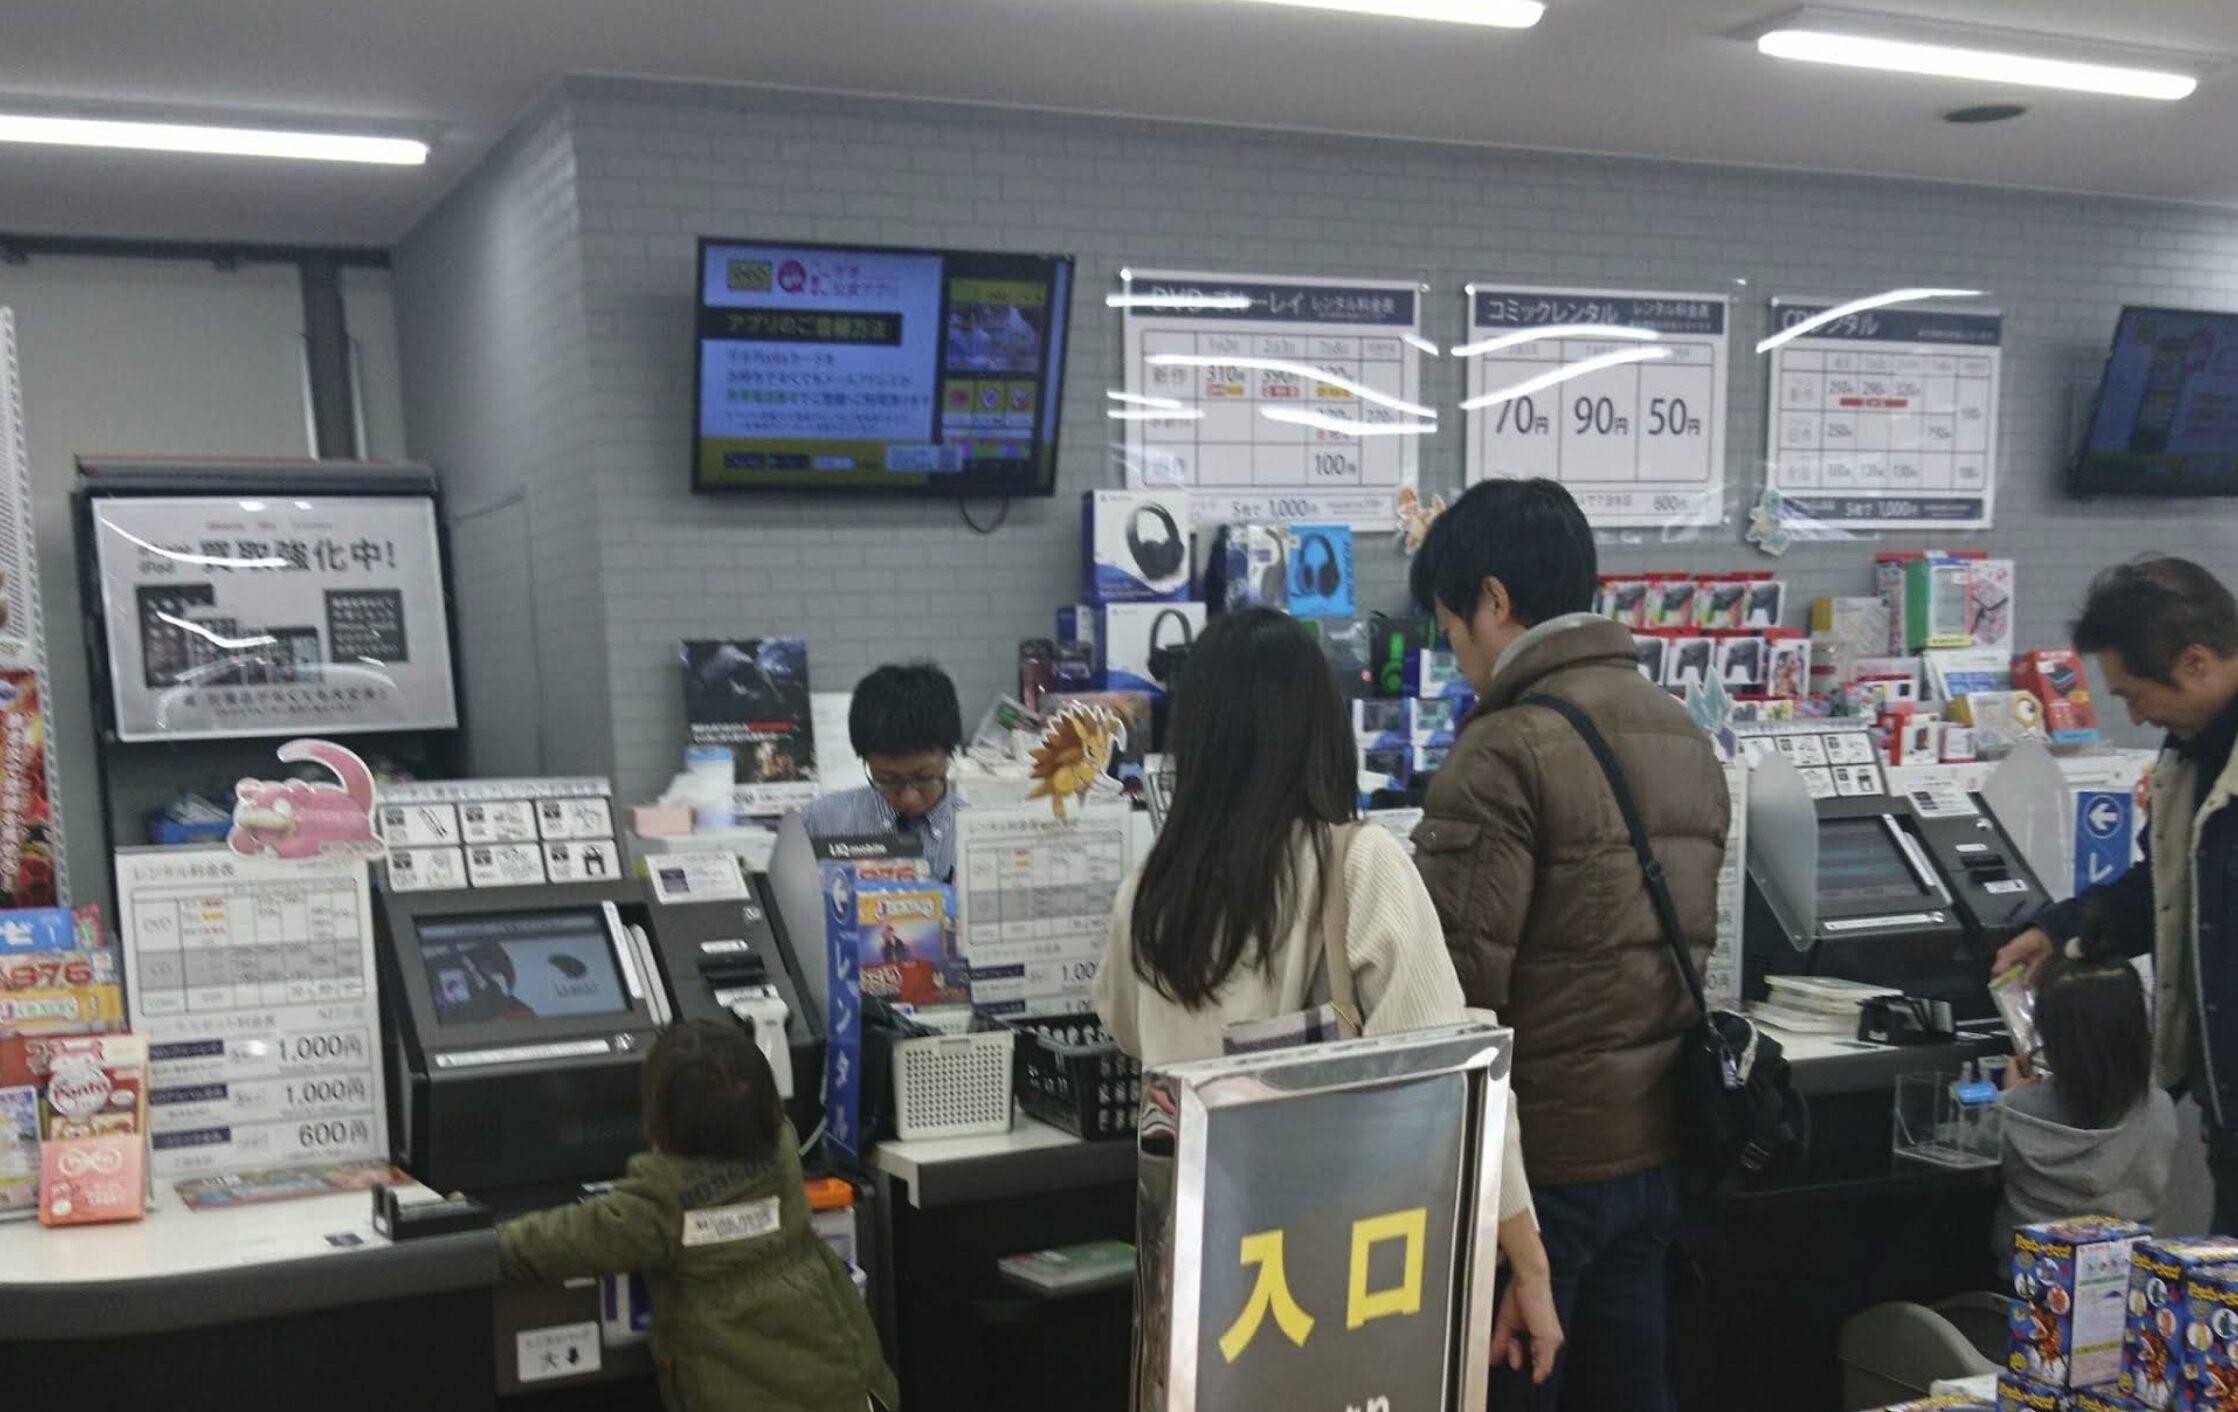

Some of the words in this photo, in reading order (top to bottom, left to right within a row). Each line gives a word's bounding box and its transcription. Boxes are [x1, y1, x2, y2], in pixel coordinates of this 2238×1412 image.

[1487, 299, 1618, 325] コミックレンタル
[1494, 395, 1549, 435] 70円
[1574, 396, 1628, 435] 90円
[1648, 397, 1701, 435] 50円
[1315, 454, 1357, 476] 100円
[298, 1121, 369, 1148] 600円
[1218, 1207, 1427, 1364] 入口
